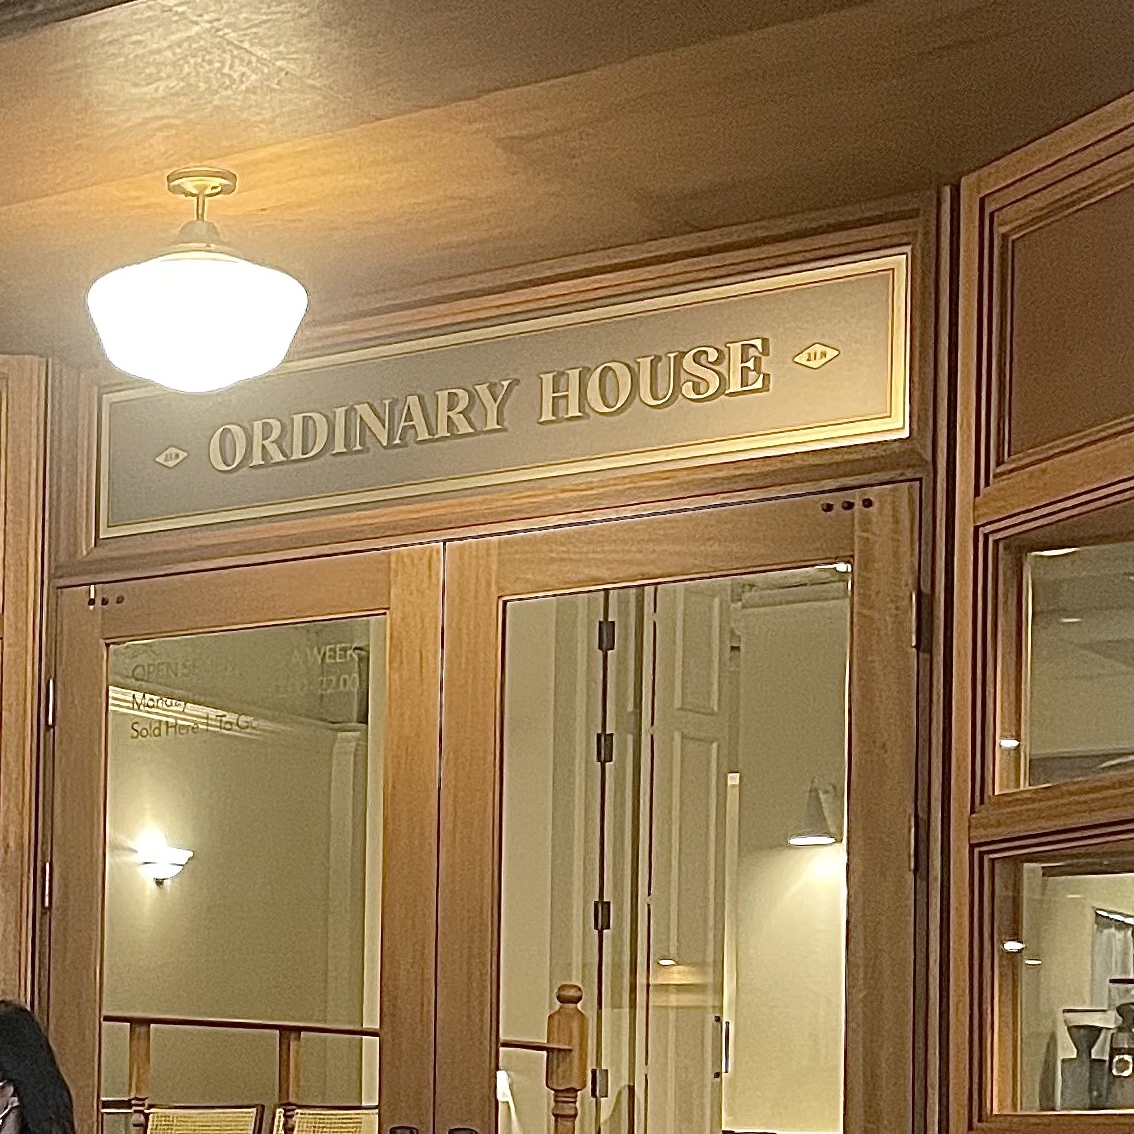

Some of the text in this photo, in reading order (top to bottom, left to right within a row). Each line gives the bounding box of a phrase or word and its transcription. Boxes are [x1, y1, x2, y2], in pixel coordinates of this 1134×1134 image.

[208, 336, 770, 473] ORDINARY HOUSE
[306, 643, 359, 666] WEEK
[130, 721, 162, 739] Sold
[166, 719, 199, 737] Here
